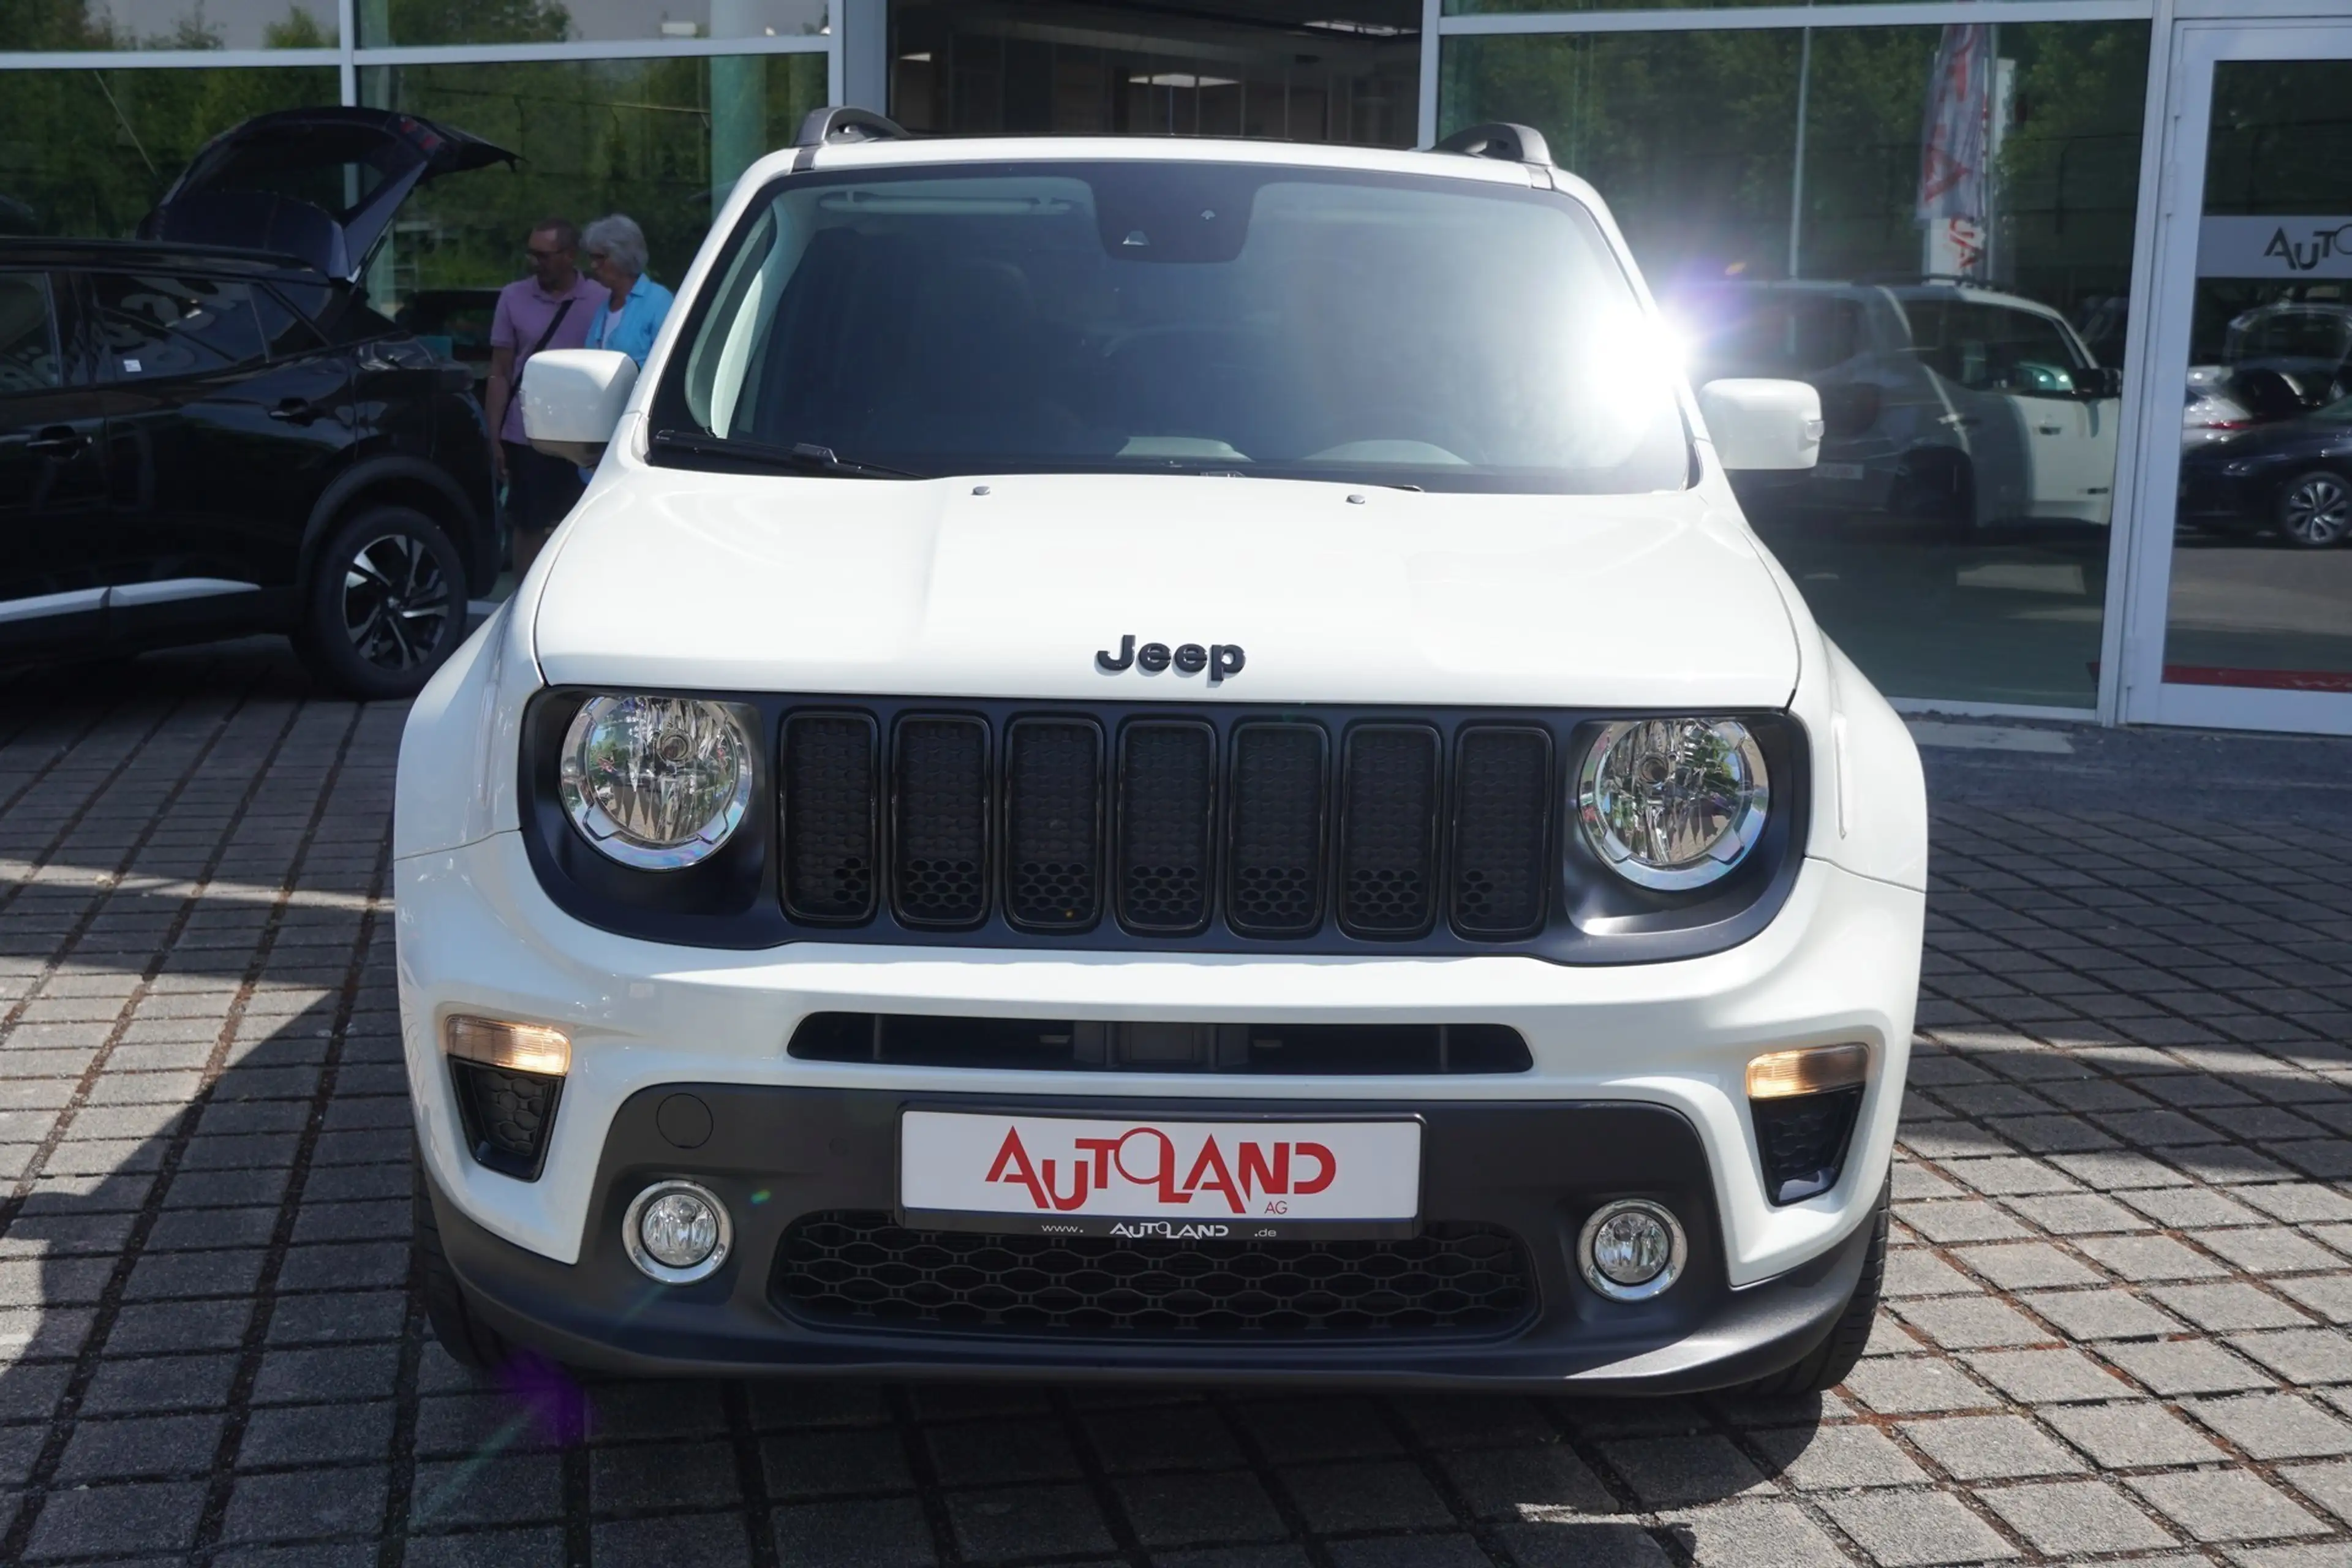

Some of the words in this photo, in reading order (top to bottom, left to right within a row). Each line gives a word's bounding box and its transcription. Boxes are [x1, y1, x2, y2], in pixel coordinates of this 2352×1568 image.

[1096, 635, 1246, 682] Jeep
[984, 1125, 1337, 1214] AUTOLAND
[1264, 1200, 1288, 1215] AG
